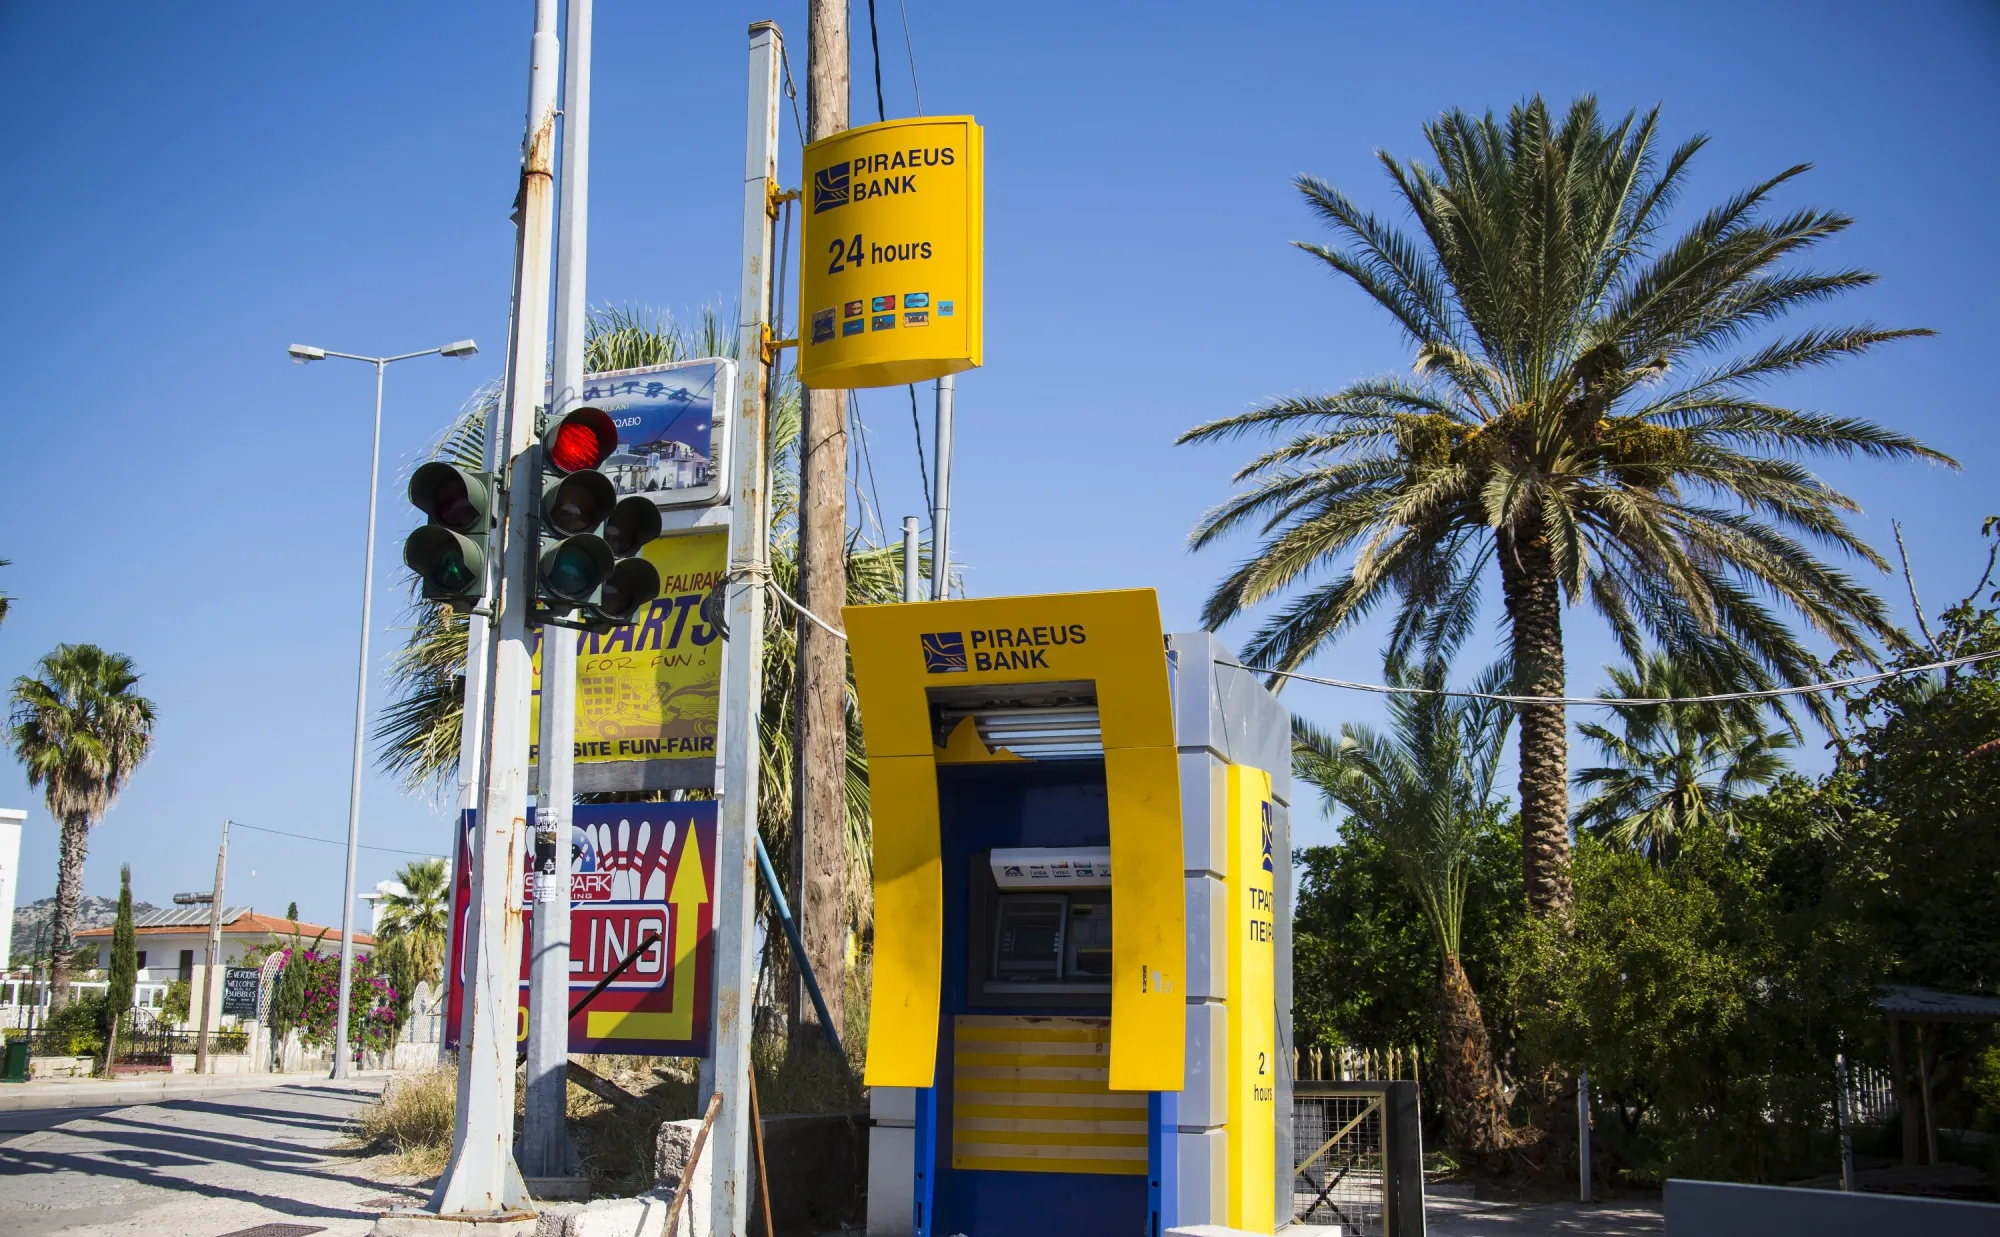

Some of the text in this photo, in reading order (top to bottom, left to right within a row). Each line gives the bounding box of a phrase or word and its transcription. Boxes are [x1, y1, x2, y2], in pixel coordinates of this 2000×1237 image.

[853, 147, 955, 177] PIRAEUS
[853, 174, 917, 201] BANK
[828, 233, 932, 275] 24 hours
[602, 402, 630, 412] AURANT
[970, 624, 1087, 649] PIRAEUS
[586, 656, 636, 672] FOR
[975, 649, 1050, 672] BANK
[619, 737, 715, 756] FUN-FAIR
[1254, 1084, 1273, 1101] hours
